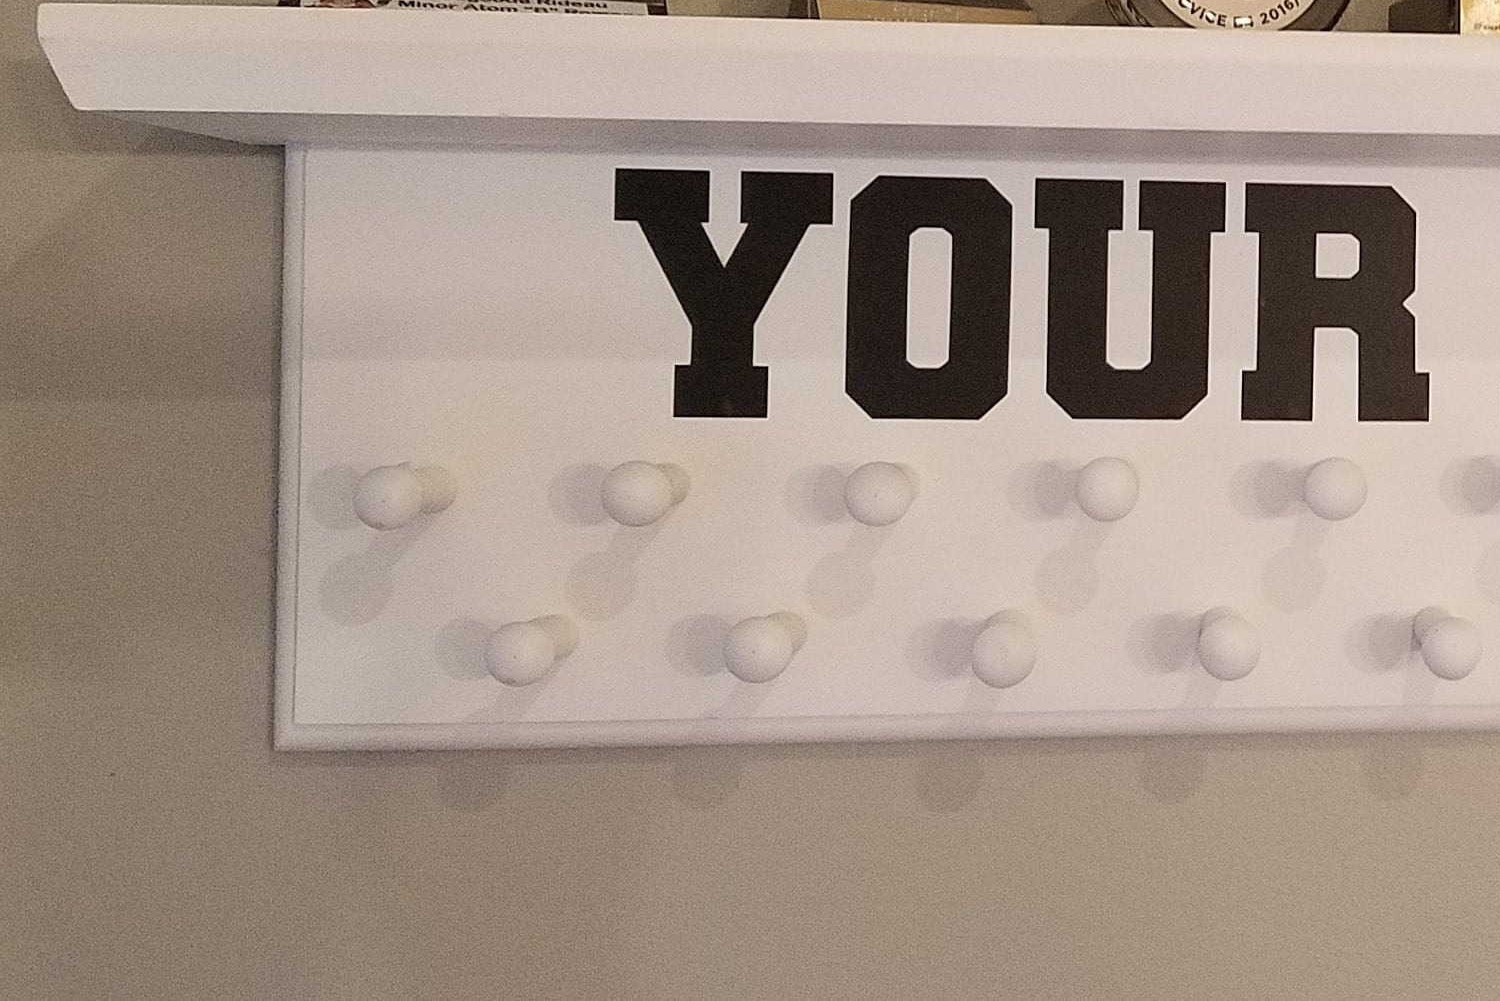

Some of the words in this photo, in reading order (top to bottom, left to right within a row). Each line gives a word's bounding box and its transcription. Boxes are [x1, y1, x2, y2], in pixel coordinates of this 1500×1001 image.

[398, 0, 457, 9] Minor
[464, 3, 518, 12] Atom
[614, 168, 1430, 422] YOUR
